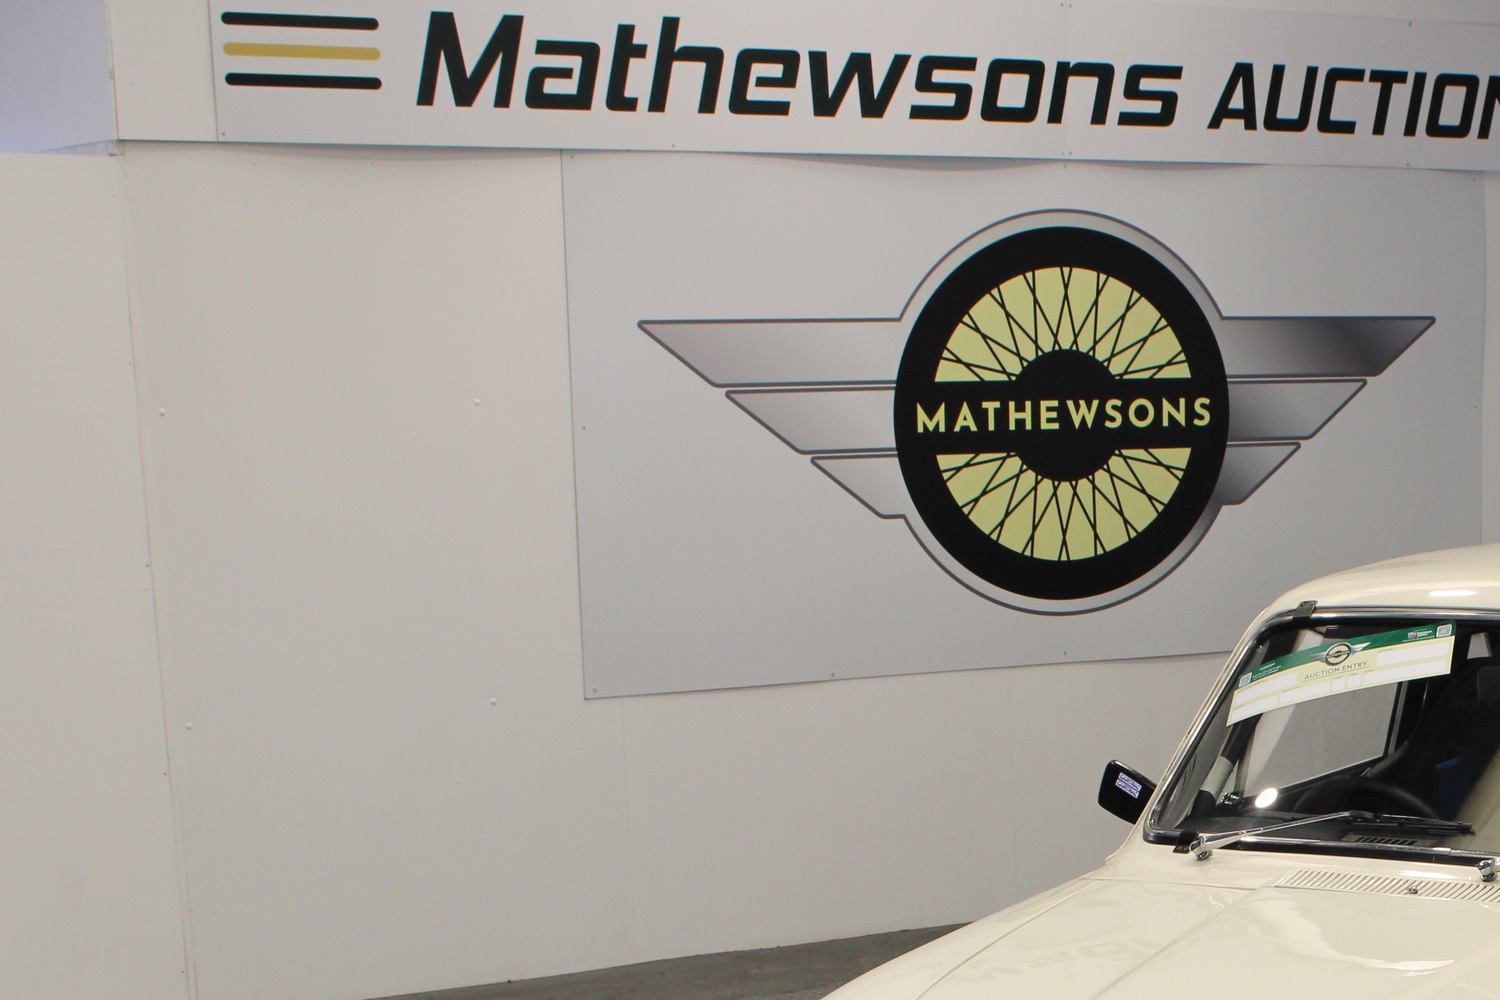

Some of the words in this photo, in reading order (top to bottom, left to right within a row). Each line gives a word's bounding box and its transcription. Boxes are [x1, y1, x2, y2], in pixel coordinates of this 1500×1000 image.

[416, 11, 1185, 128] Mathewsons
[916, 397, 1213, 434] MATHEWSONS
[1304, 667, 1340, 680] AUCTION
[1342, 661, 1369, 672] ENTRY
